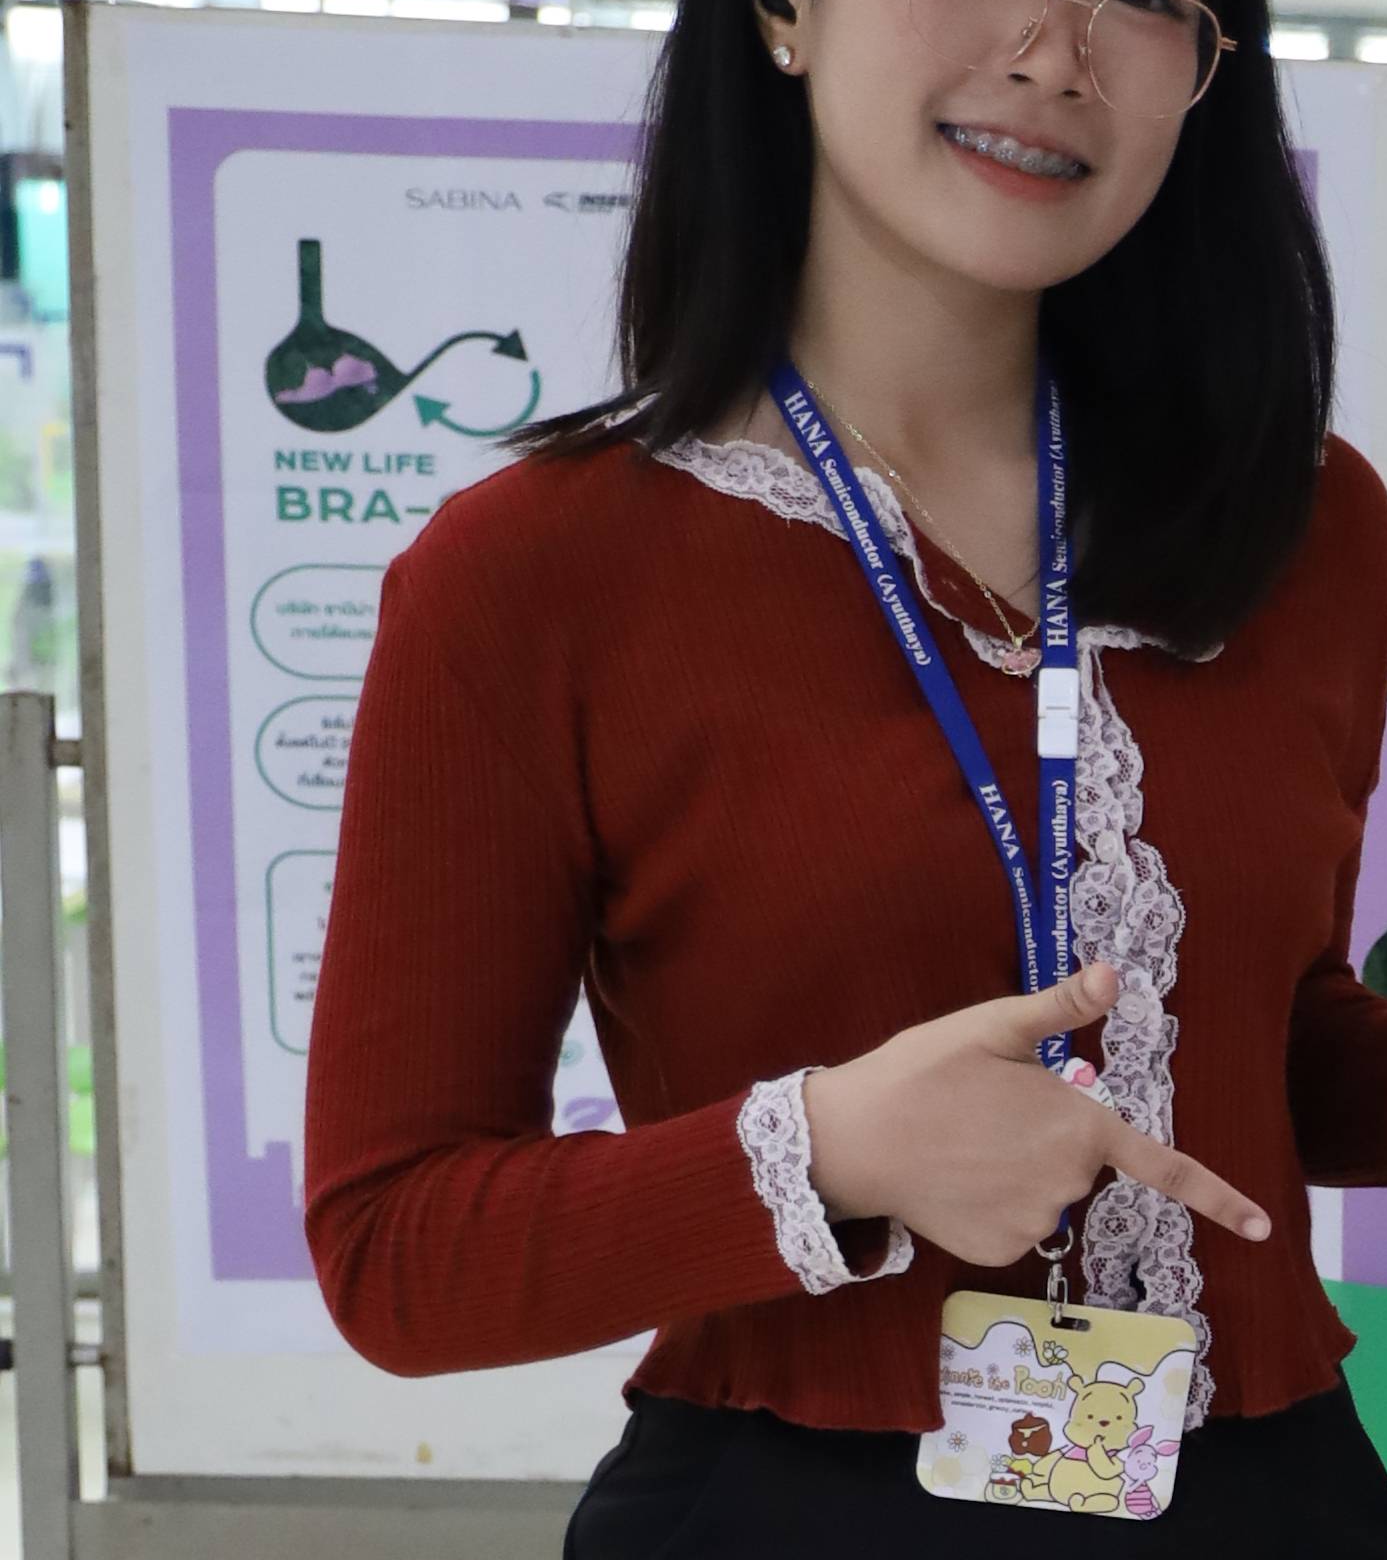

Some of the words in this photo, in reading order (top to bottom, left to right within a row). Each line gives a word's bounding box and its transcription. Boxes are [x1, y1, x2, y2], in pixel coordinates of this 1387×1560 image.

[404, 188, 523, 211] SABINA
[274, 449, 353, 472] NEW
[363, 452, 436, 476] LIFE
[276, 485, 433, 523] BRA-
[784, 390, 832, 458] HANA
[819, 457, 885, 570] Semiconductor
[876, 573, 932, 667] (Ayutthaya)
[1046, 578, 1069, 647] HANA
[1051, 780, 1072, 881] (Ayutthaya)
[979, 783, 1021, 861] HANA
[1012, 866, 1040, 994] Semiconductor
[1013, 1364, 1068, 1401] Pooh
